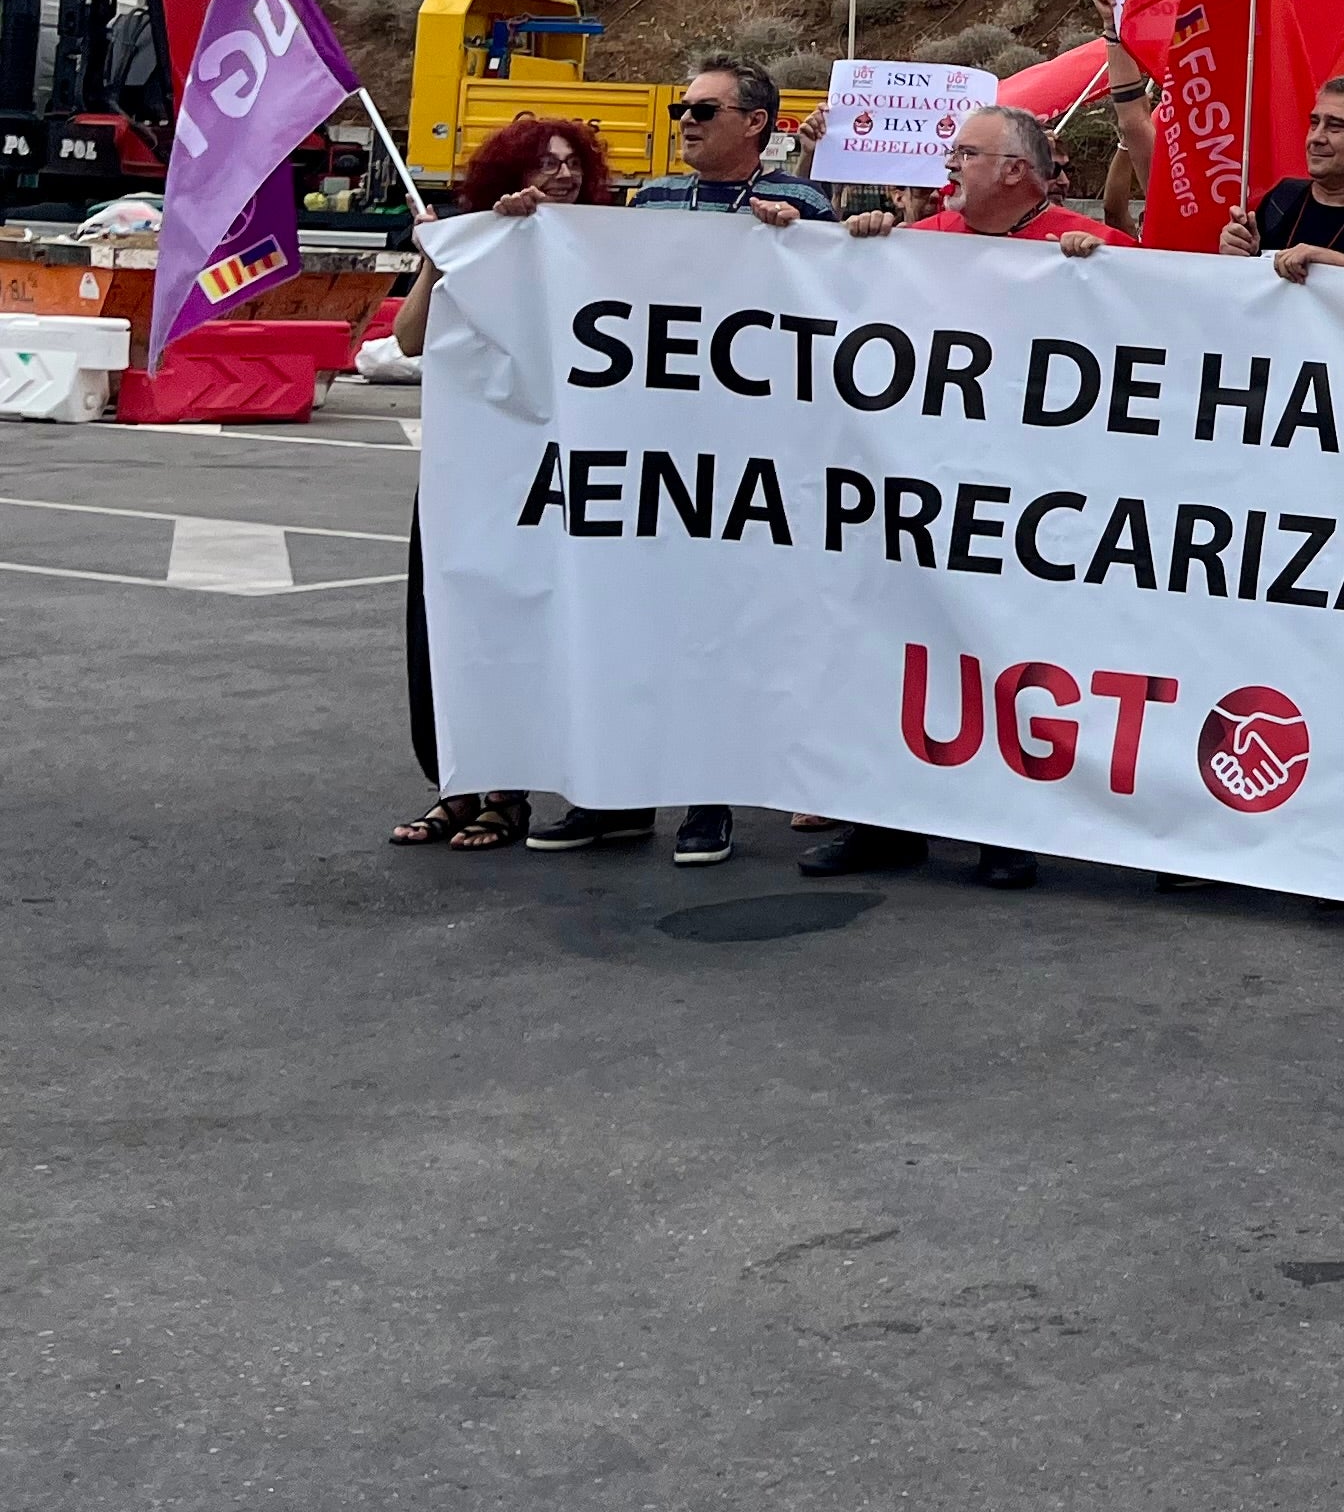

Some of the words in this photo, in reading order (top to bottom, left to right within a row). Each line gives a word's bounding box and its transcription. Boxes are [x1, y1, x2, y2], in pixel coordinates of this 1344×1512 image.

[884, 118, 928, 132] HAY
[887, 72, 932, 87] ¡SIN
[1179, 47, 1243, 204] FeSMC
[1165, 121, 1199, 218] Balears
[567, 300, 993, 421] SECTOR
[1021, 338, 1167, 436] DE
[516, 441, 793, 546] AENA
[901, 643, 1179, 795] UGT
